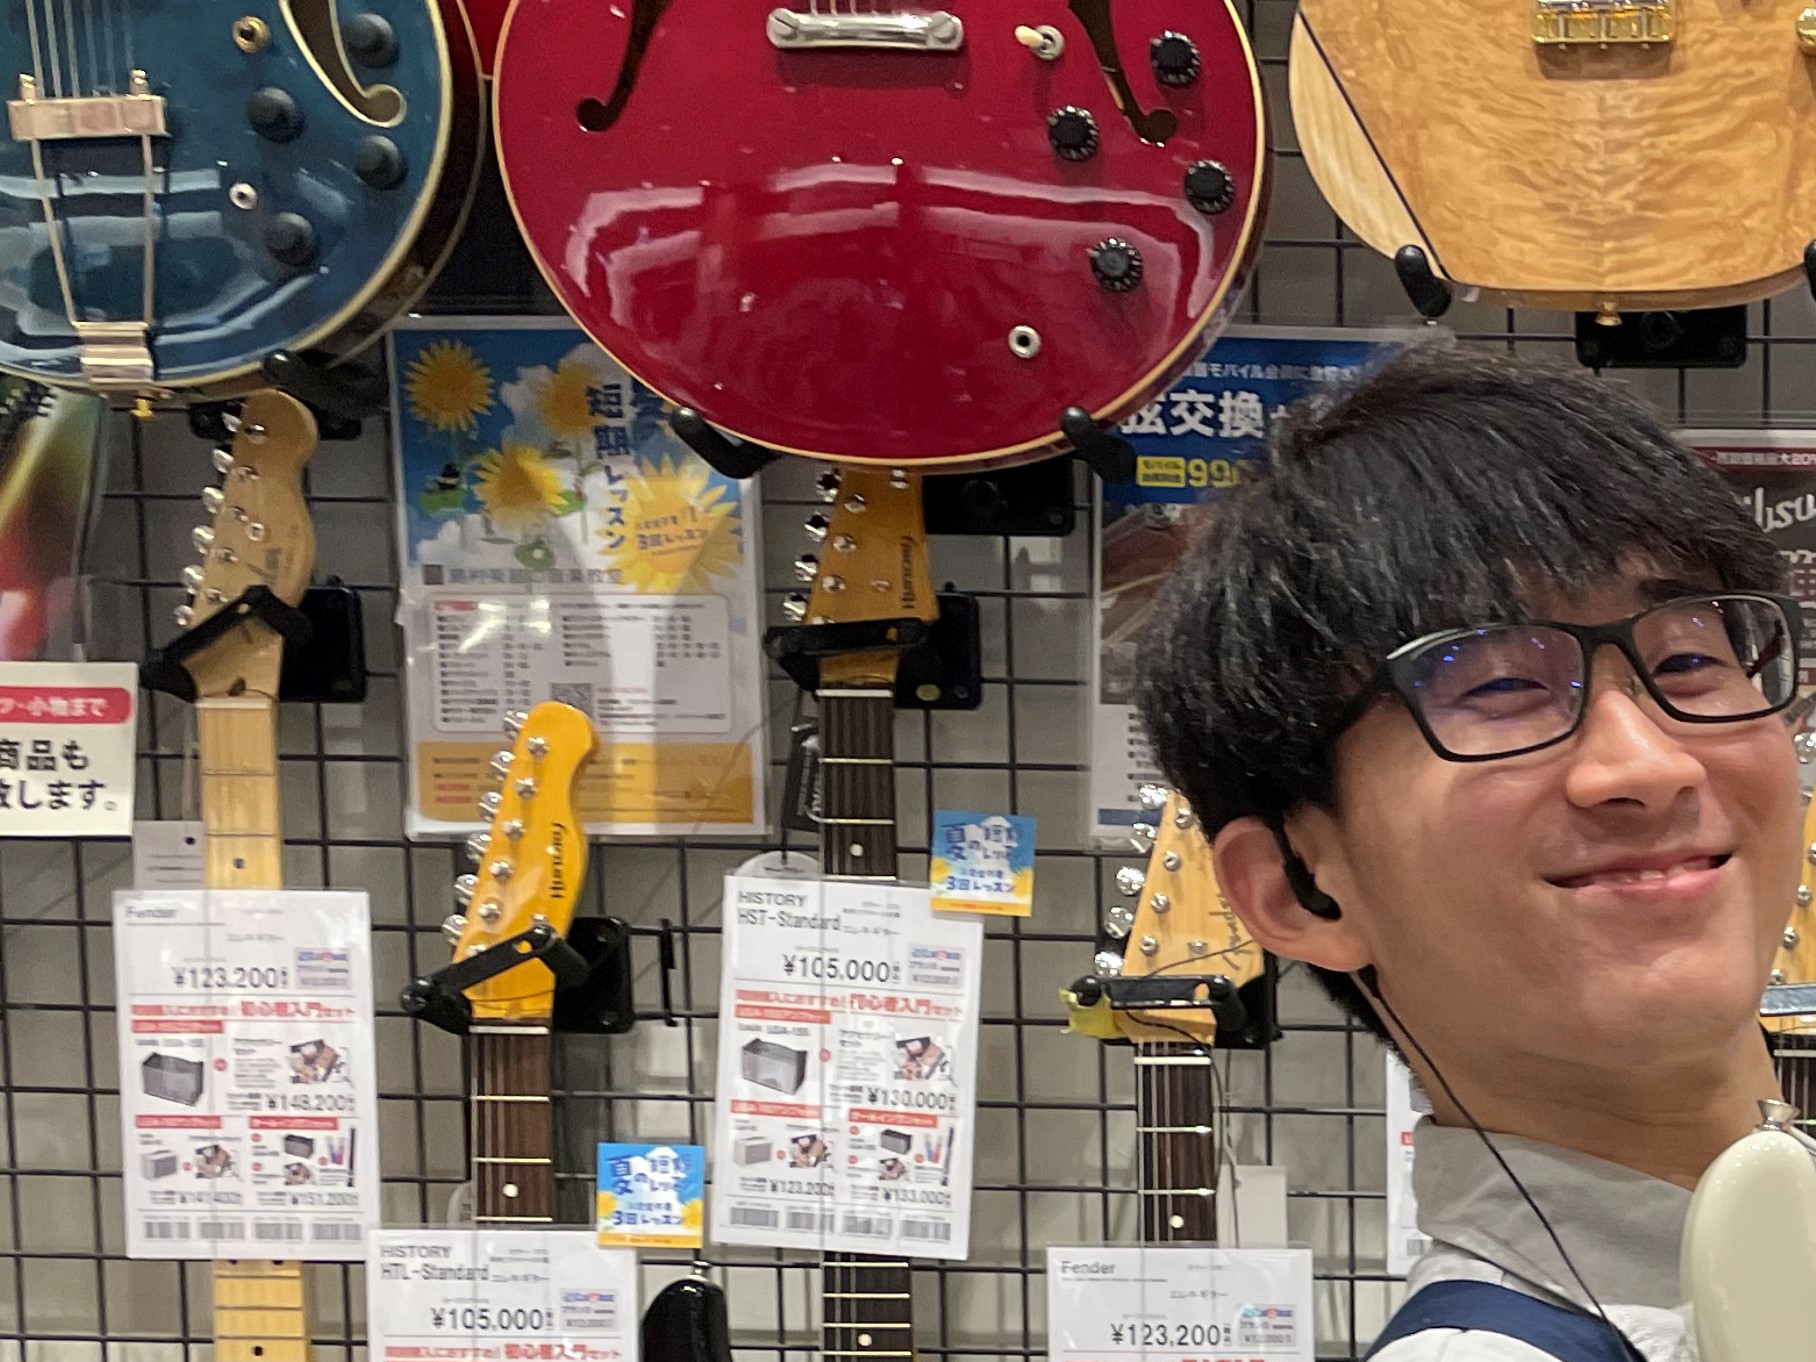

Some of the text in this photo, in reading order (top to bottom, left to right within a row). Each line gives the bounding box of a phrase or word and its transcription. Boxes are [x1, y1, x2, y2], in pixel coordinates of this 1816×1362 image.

[0, 739, 89, 771] 商品も
[738, 890, 808, 907] HISTORY
[737, 909, 842, 933] HST-Standard
[172, 965, 279, 990] ¥123,200
[782, 953, 890, 986] ¥105,000
[1061, 1261, 1116, 1276] Fender
[430, 1306, 545, 1332] ¥105,000
[1110, 1323, 1221, 1348] ¥123,200
